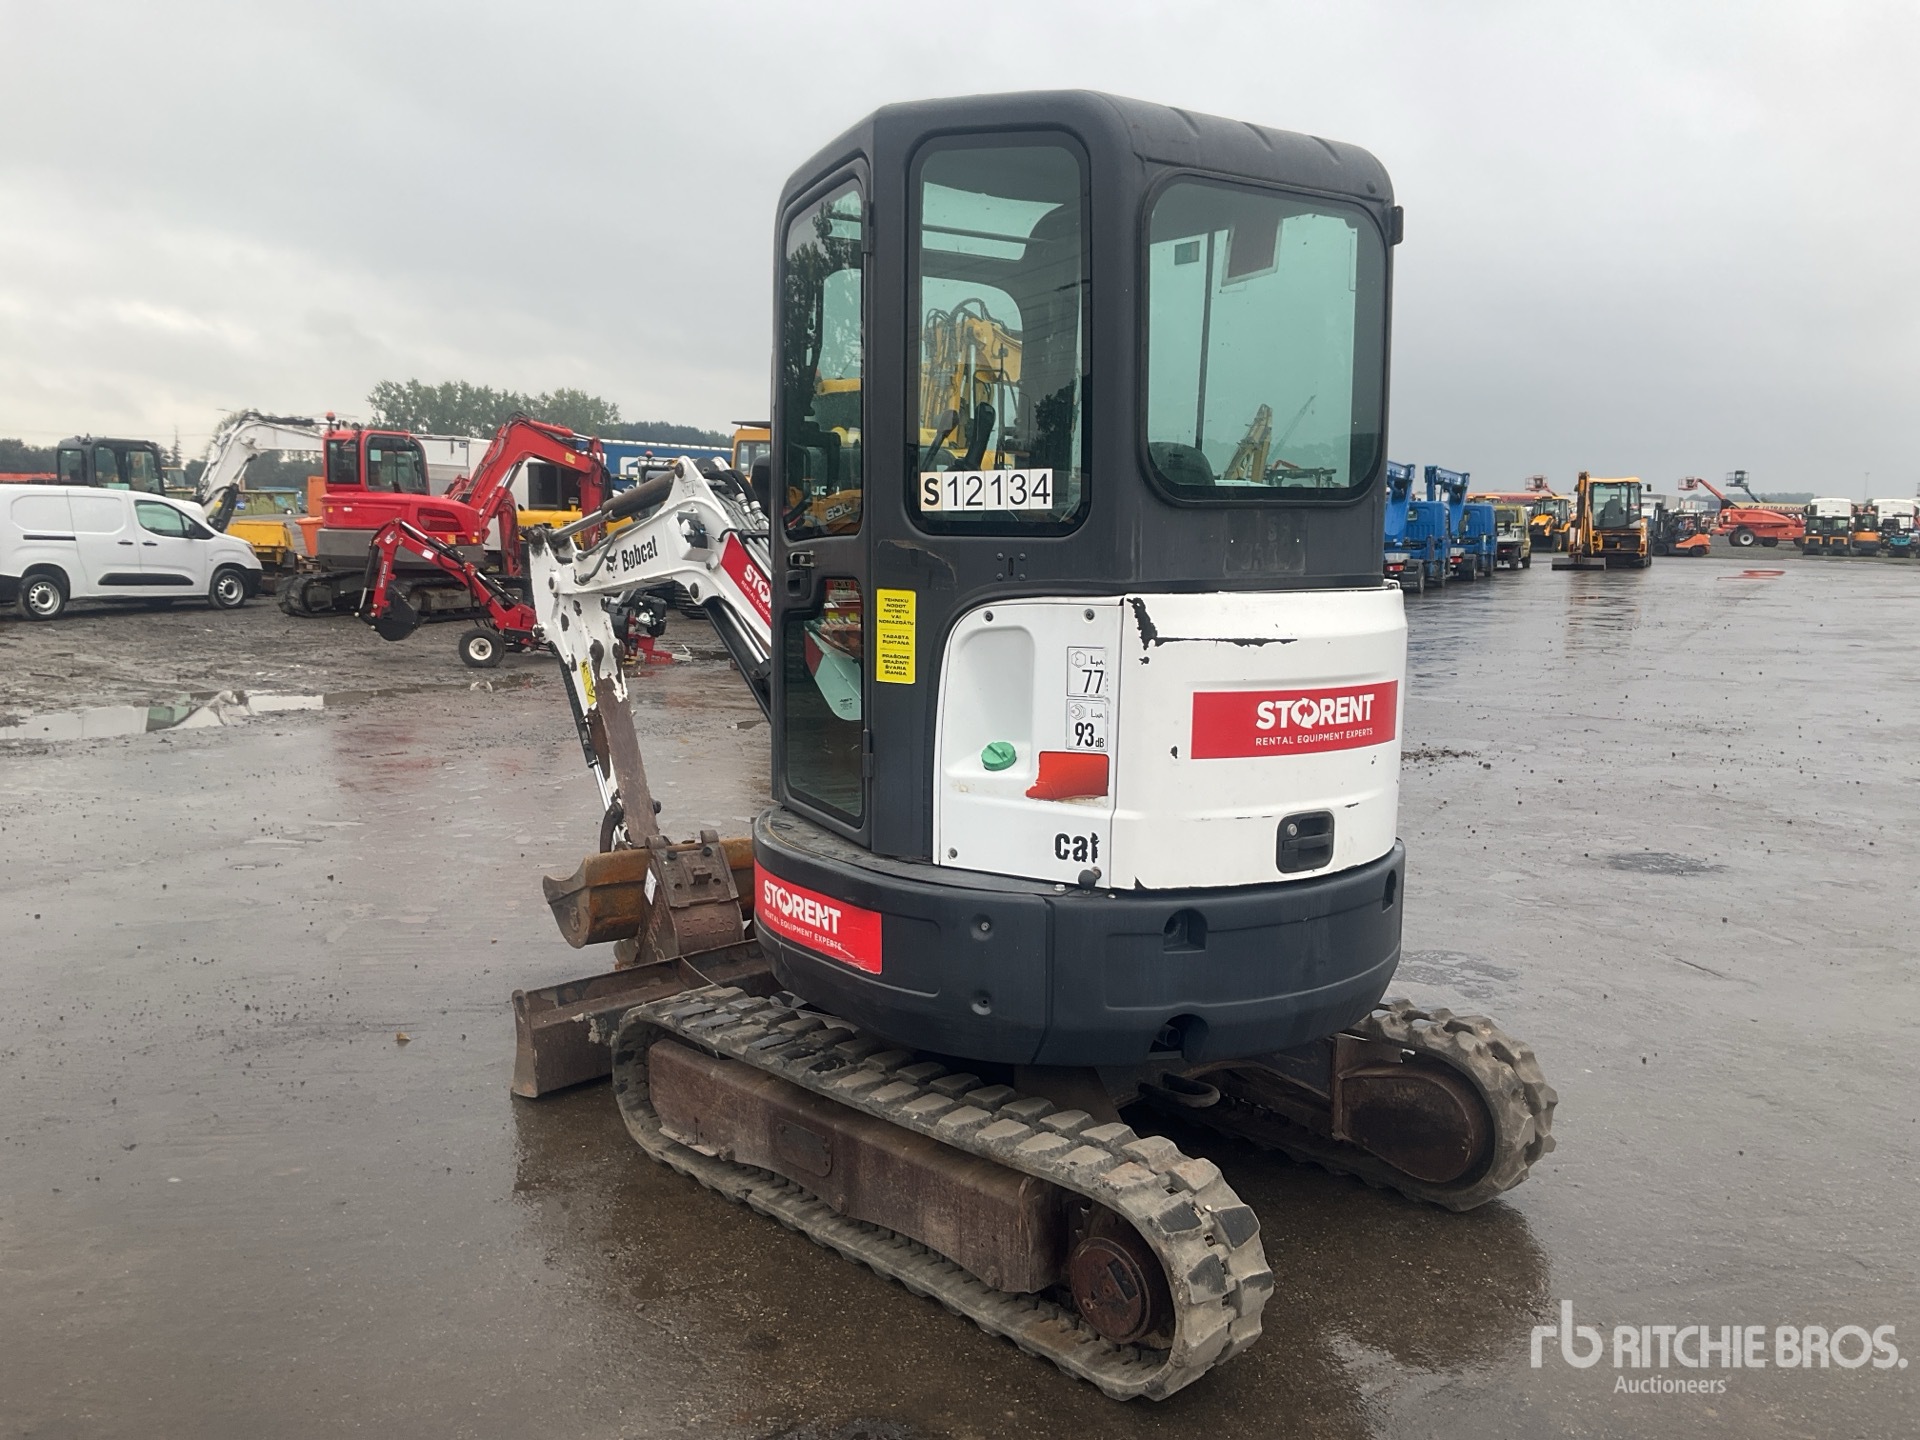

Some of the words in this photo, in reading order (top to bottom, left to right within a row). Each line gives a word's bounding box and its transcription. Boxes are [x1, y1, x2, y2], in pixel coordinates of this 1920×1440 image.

[923, 473, 1050, 506] S12134
[621, 535, 659, 572] Bobcat
[744, 563, 772, 609] STO
[1082, 669, 1104, 694] 77
[1255, 693, 1375, 730] STORENT
[1255, 736, 1294, 746] RENTAL
[1297, 731, 1344, 744] EQUIPMENT
[1346, 727, 1373, 739] EXPERTS
[764, 879, 841, 935] STORENT
[764, 908, 780, 925] RENTAL
[780, 918, 813, 939] EQUIPMENT
